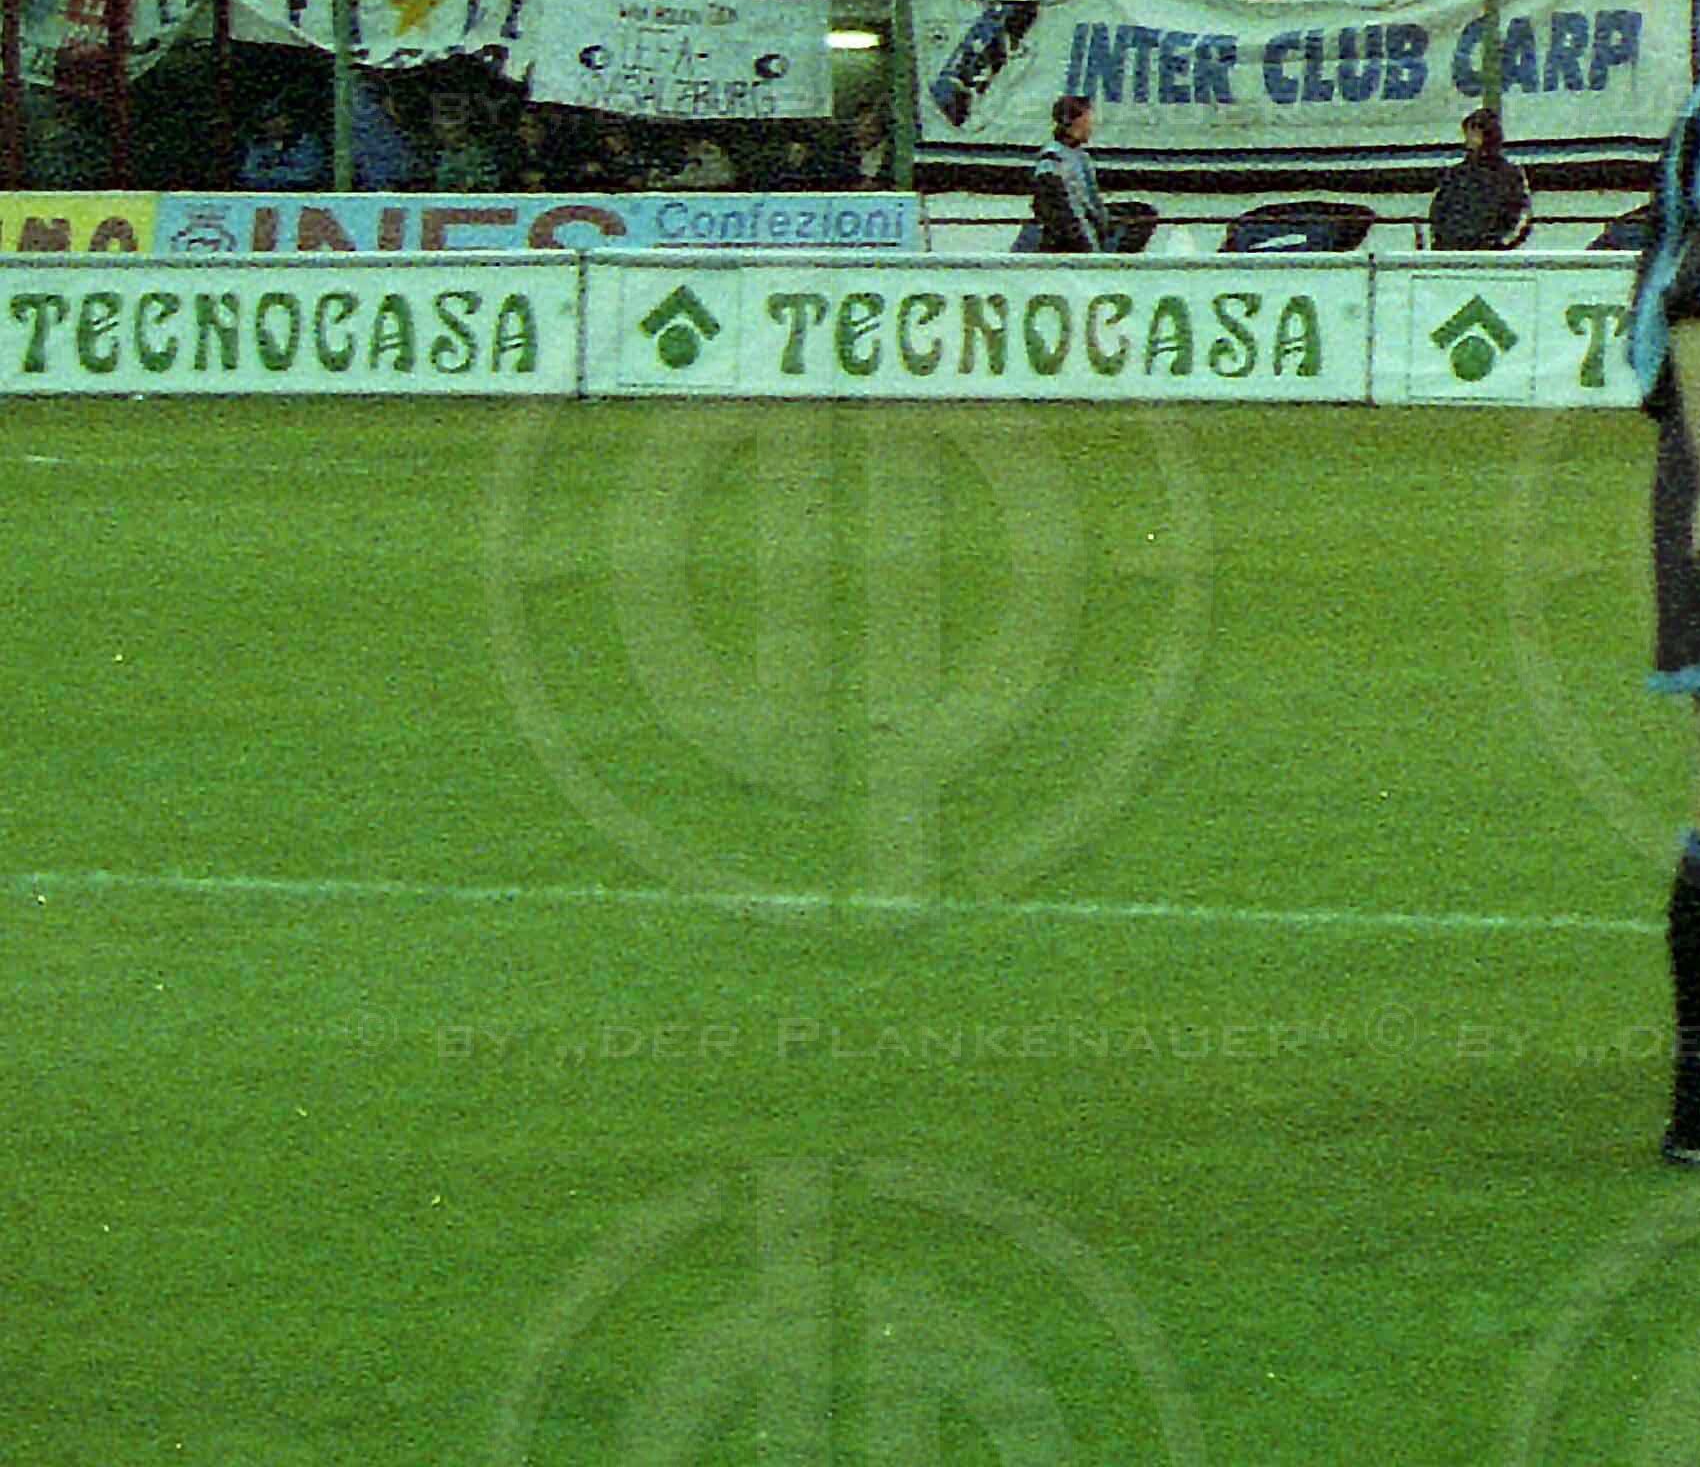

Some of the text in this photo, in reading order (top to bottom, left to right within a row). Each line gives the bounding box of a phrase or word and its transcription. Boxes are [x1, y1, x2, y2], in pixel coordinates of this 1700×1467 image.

[1066, 21, 1240, 106] INTER
[1262, 21, 1430, 106] CLUB
[655, 200, 906, 241] Confezioni
[9, 291, 540, 375] TECNOCASA
[767, 291, 1323, 378] TECNOCASA
